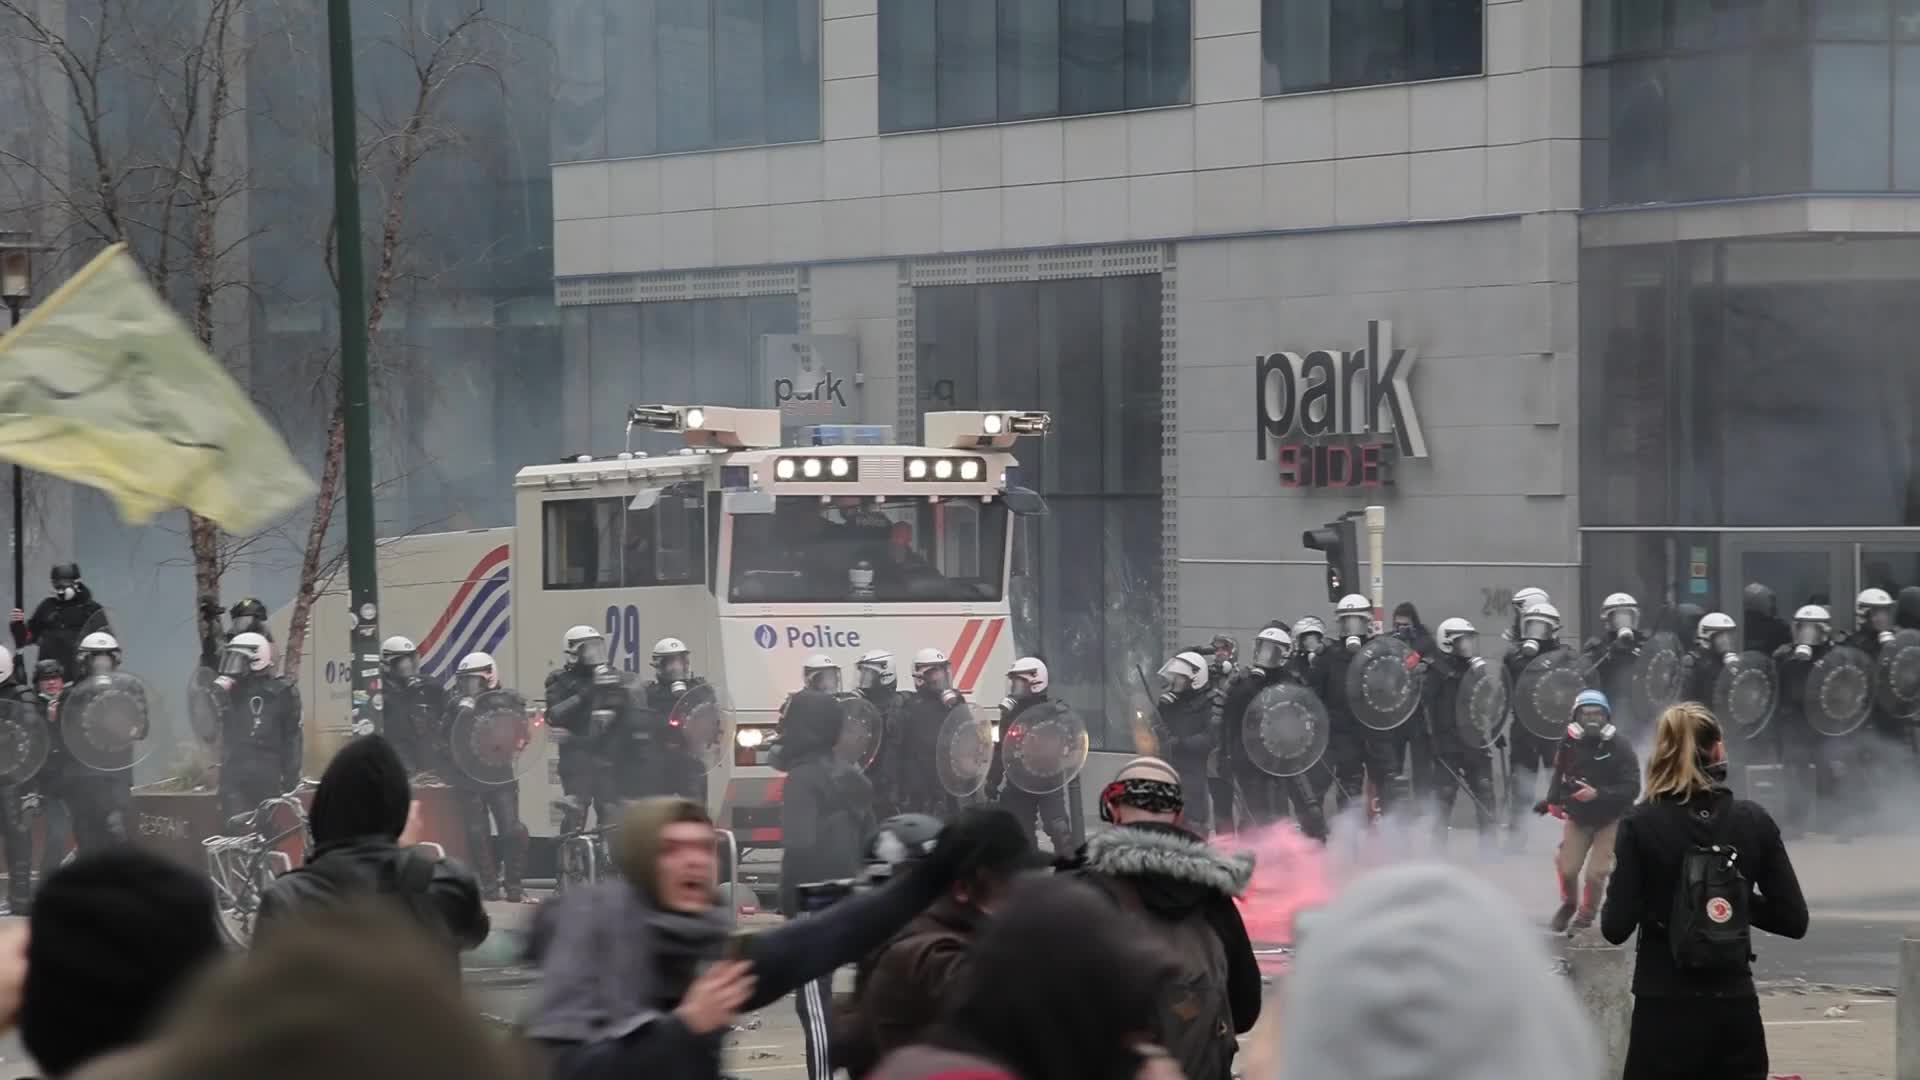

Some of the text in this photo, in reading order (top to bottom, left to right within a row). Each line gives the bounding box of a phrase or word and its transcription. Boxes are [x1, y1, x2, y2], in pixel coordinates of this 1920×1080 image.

[1256, 320, 1426, 461] park
[1279, 444, 1394, 488] SIDE
[606, 605, 640, 674] 29
[786, 625, 861, 649] Police
